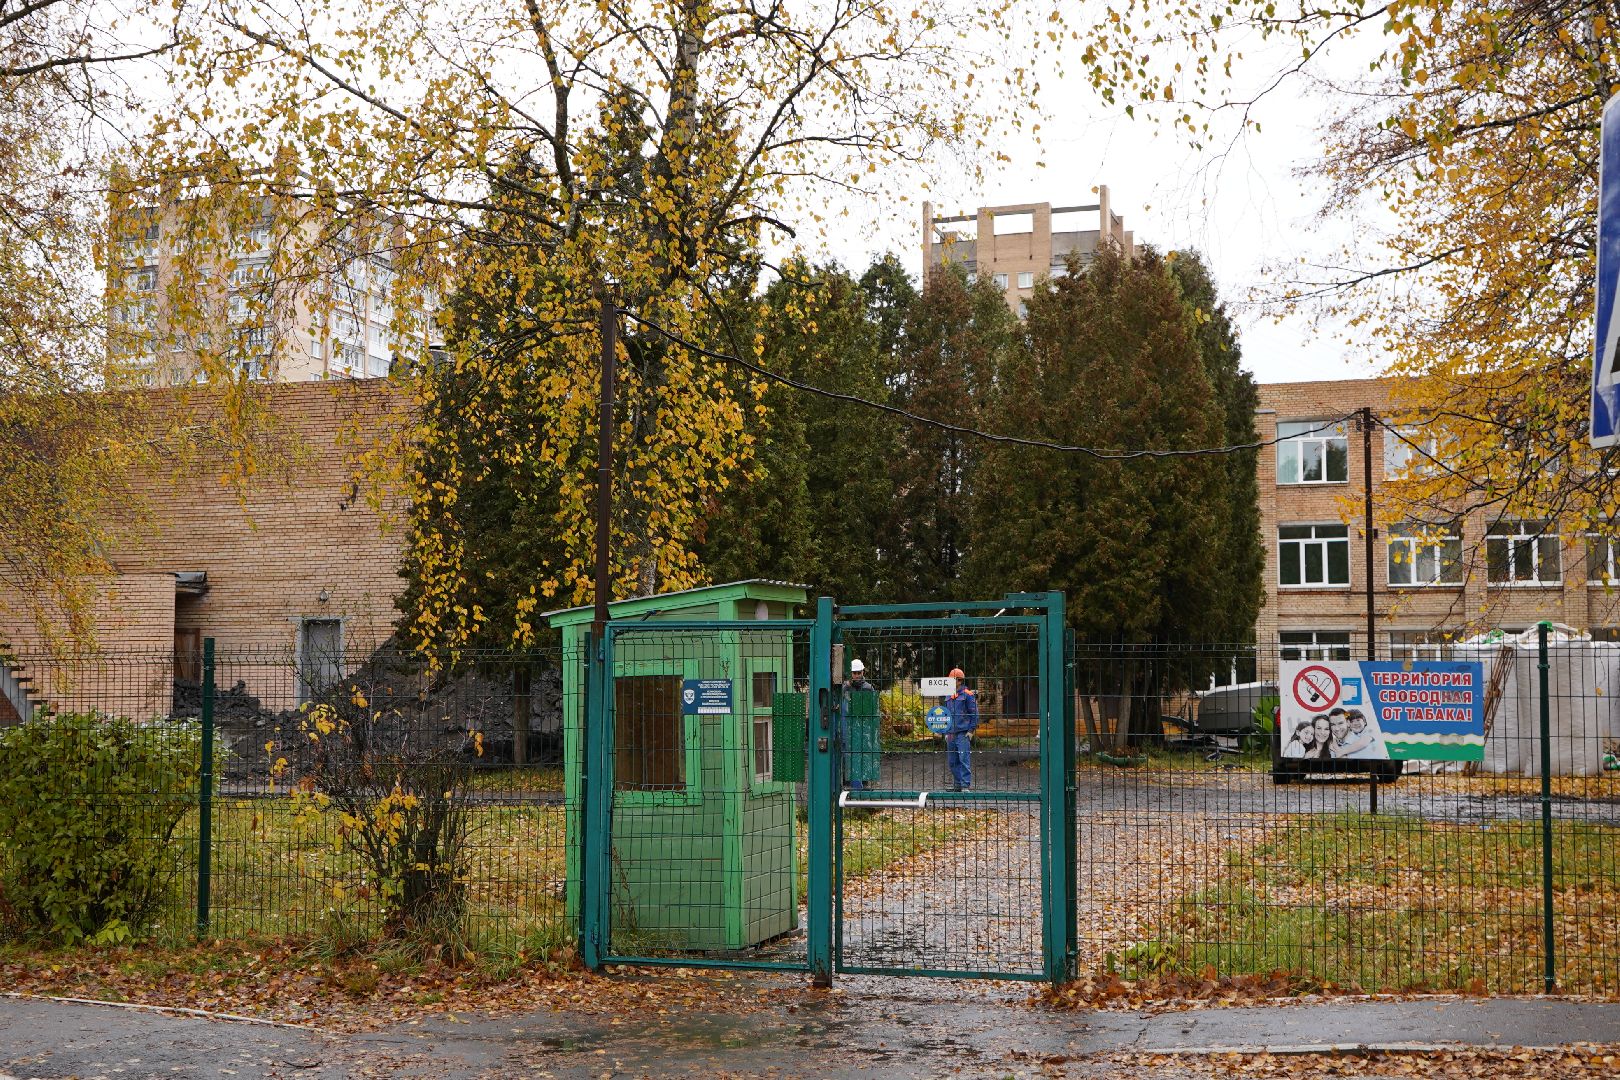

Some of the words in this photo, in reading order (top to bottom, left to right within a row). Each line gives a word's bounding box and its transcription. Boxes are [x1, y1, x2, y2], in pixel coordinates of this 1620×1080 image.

[1372, 672, 1472, 686] ТЕРРИТОРИЯ
[1379, 690, 1472, 706] СВОБОДНАЯ
[1382, 706, 1402, 720] ОТ
[1405, 707, 1472, 722] ТАБАКА!
